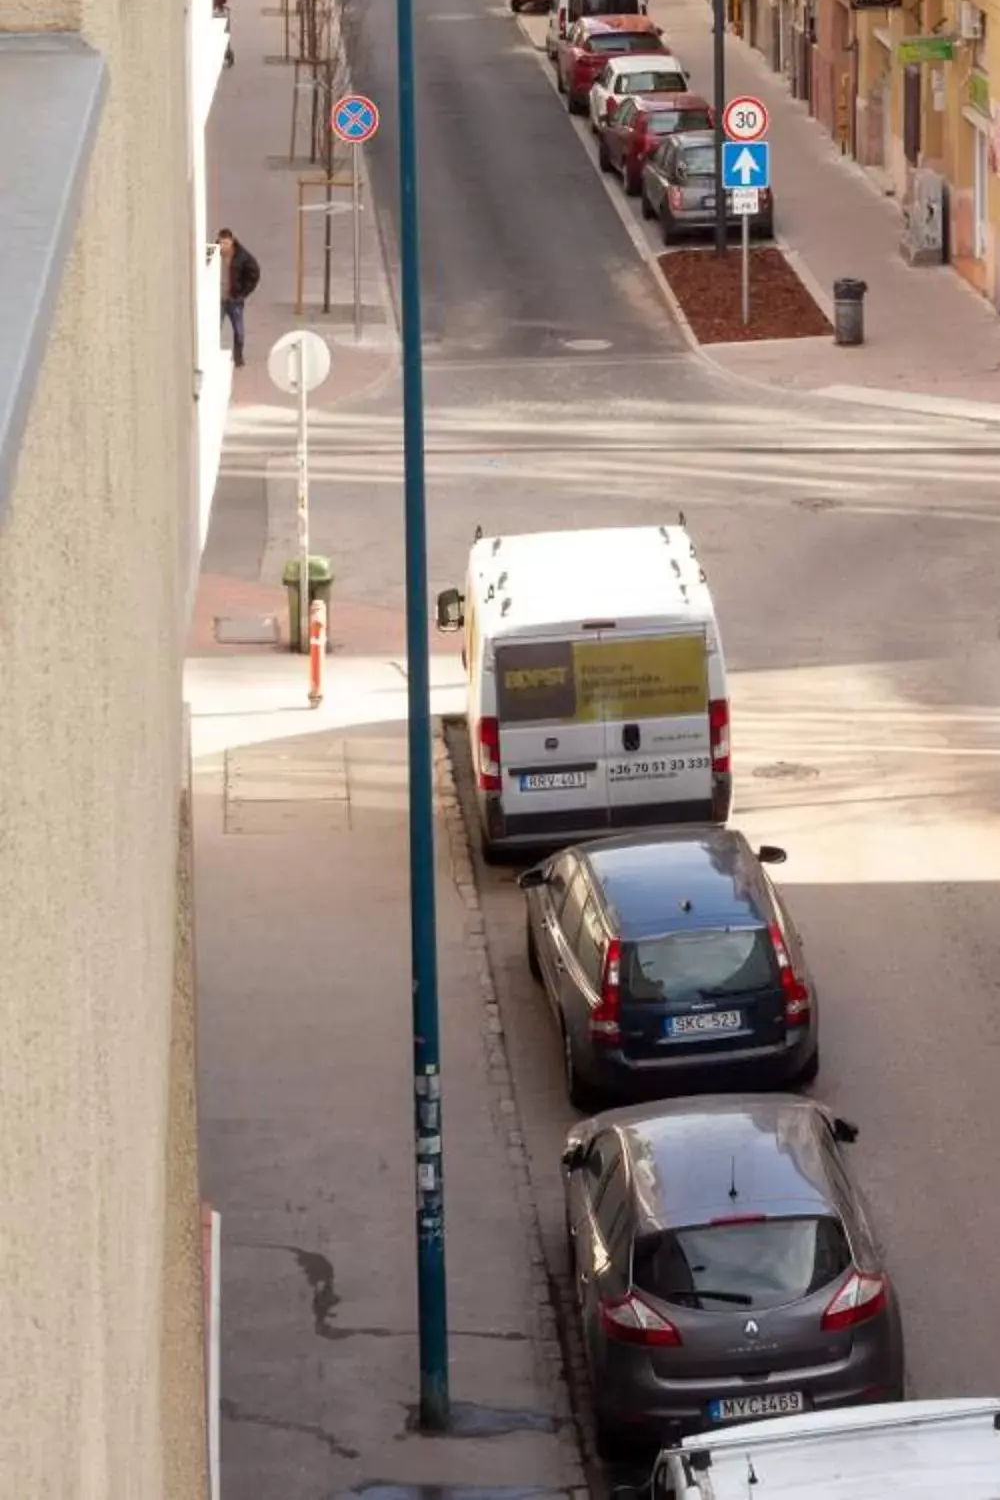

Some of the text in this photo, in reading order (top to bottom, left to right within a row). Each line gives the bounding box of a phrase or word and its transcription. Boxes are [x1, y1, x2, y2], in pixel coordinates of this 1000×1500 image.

[735, 111, 757, 129] 30
[610, 764, 631, 775] +36
[634, 762, 649, 773] 70
[670, 759, 685, 771] 33
